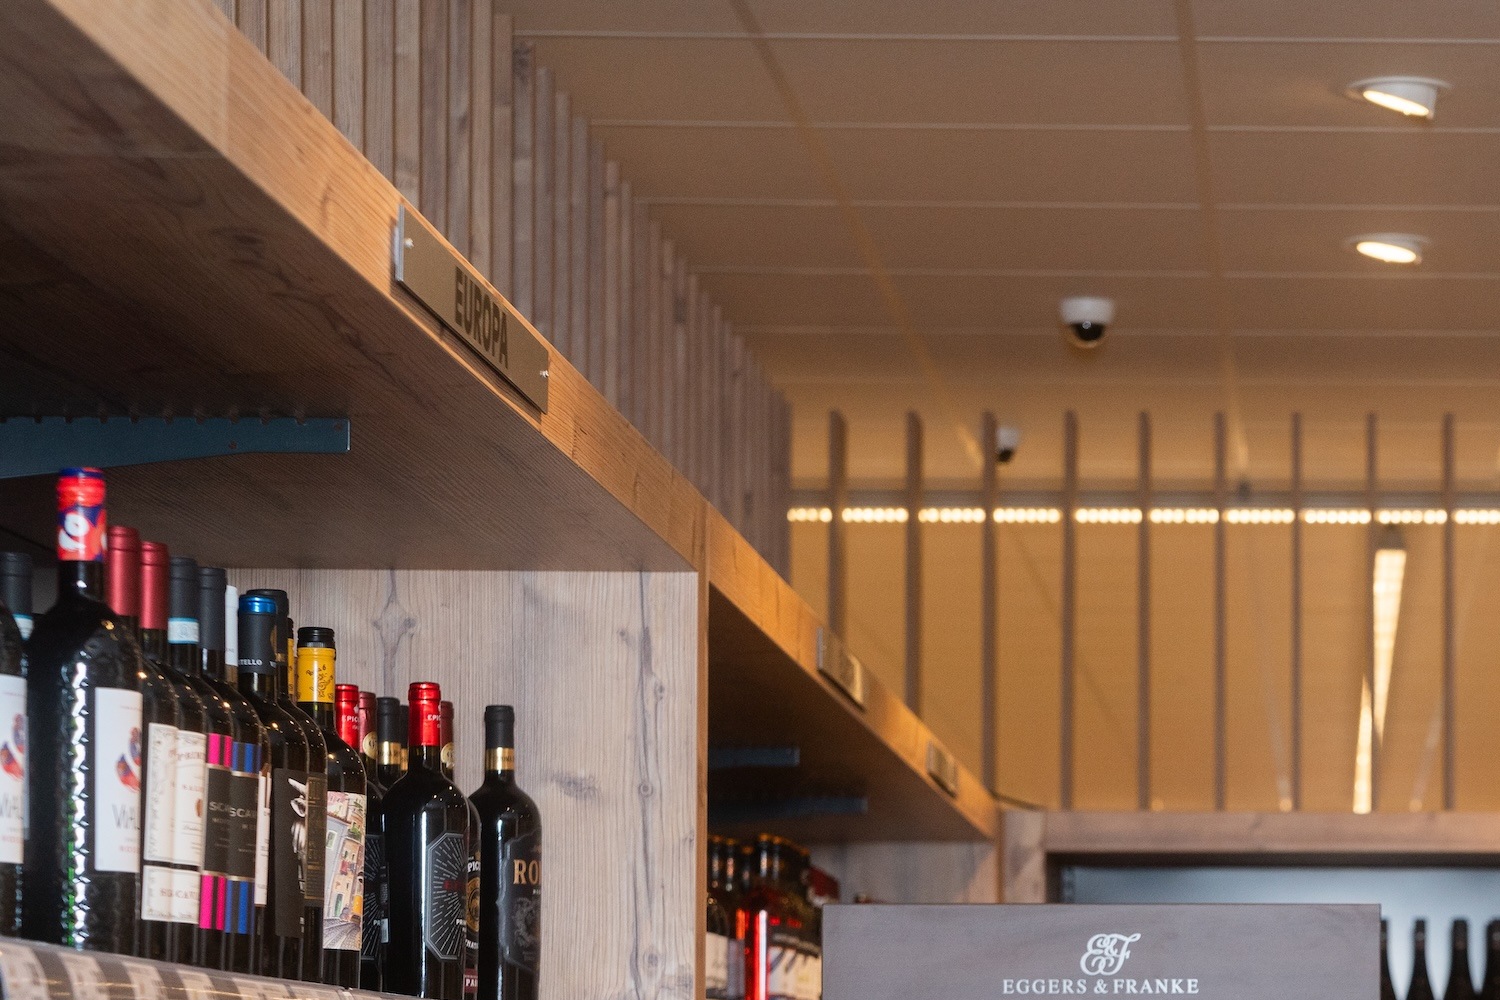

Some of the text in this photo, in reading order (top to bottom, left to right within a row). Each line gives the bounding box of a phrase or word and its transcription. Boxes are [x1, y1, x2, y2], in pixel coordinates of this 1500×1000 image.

[454, 265, 509, 370] EUROPA
[1002, 978, 1200, 995] EGGERS & FRANKE
